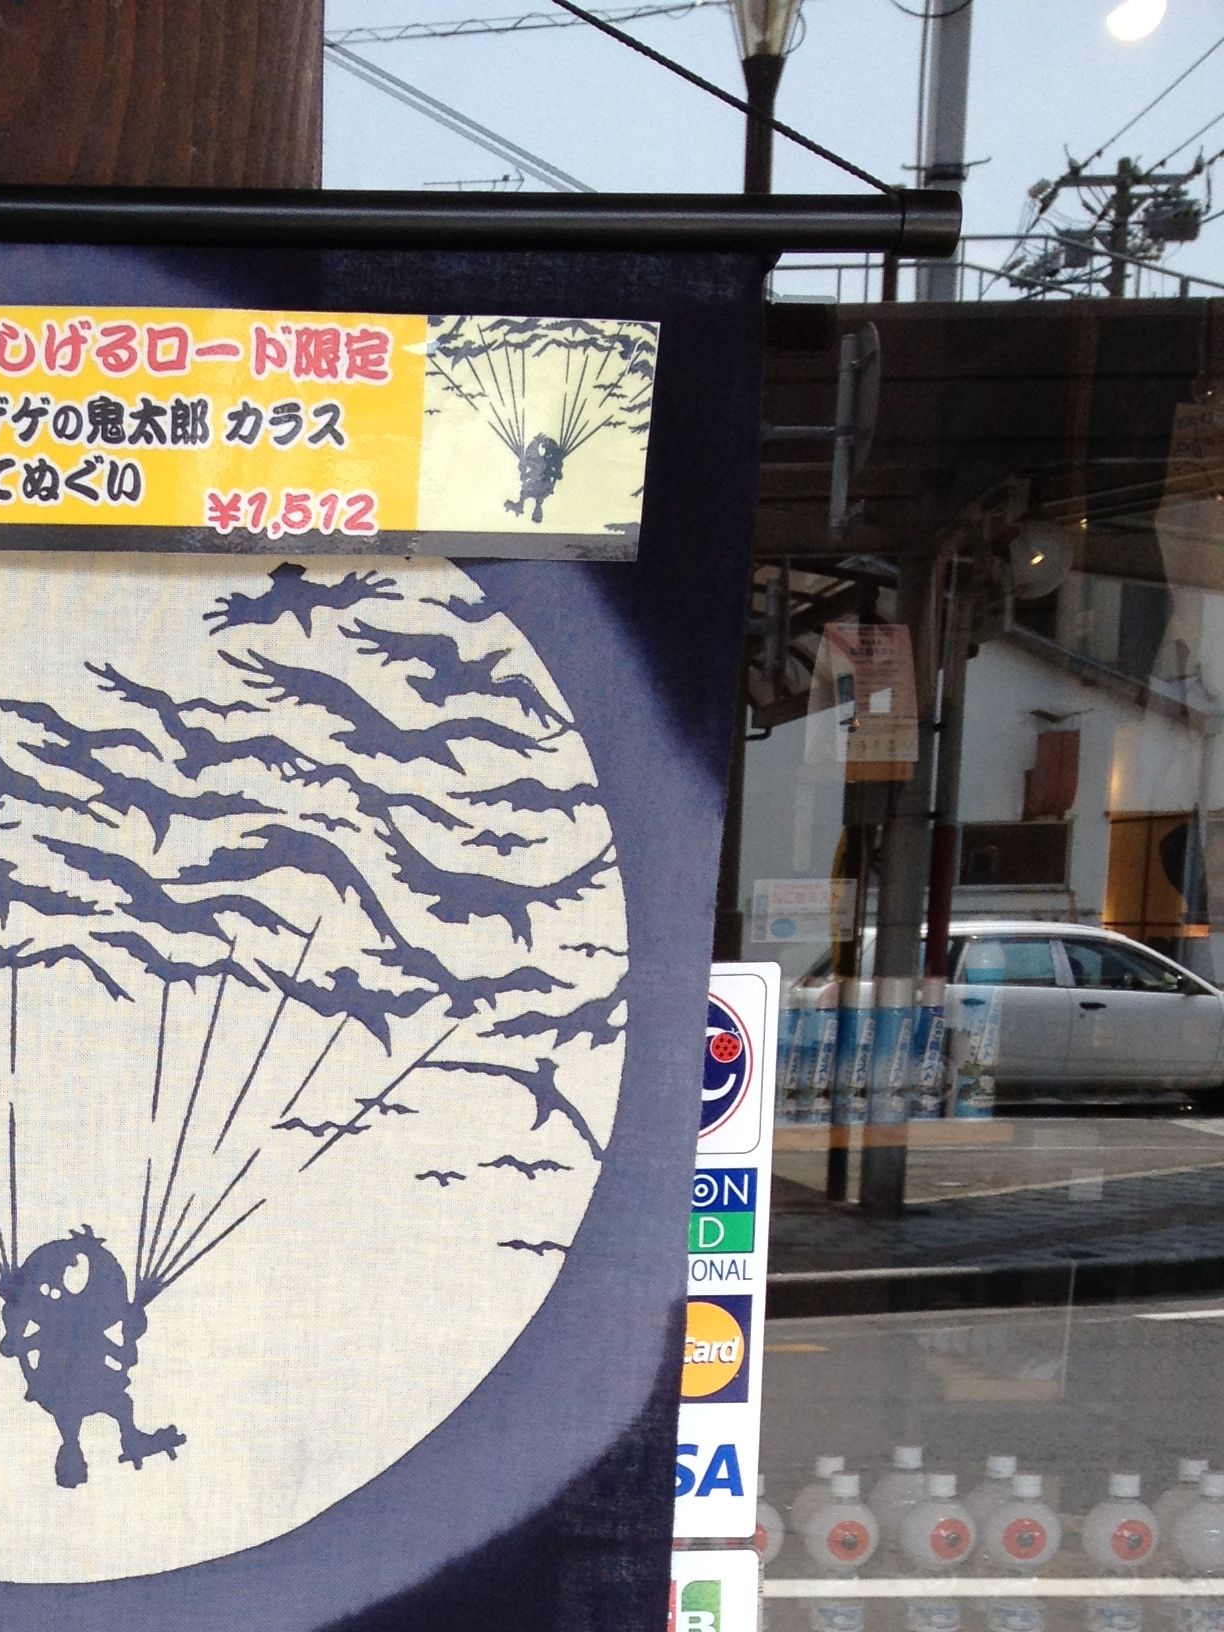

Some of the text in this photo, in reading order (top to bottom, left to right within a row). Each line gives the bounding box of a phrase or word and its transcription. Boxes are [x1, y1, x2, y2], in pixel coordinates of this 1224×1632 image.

[226, 400, 345, 446] カラス
[208, 492, 376, 537] ¥1,512
